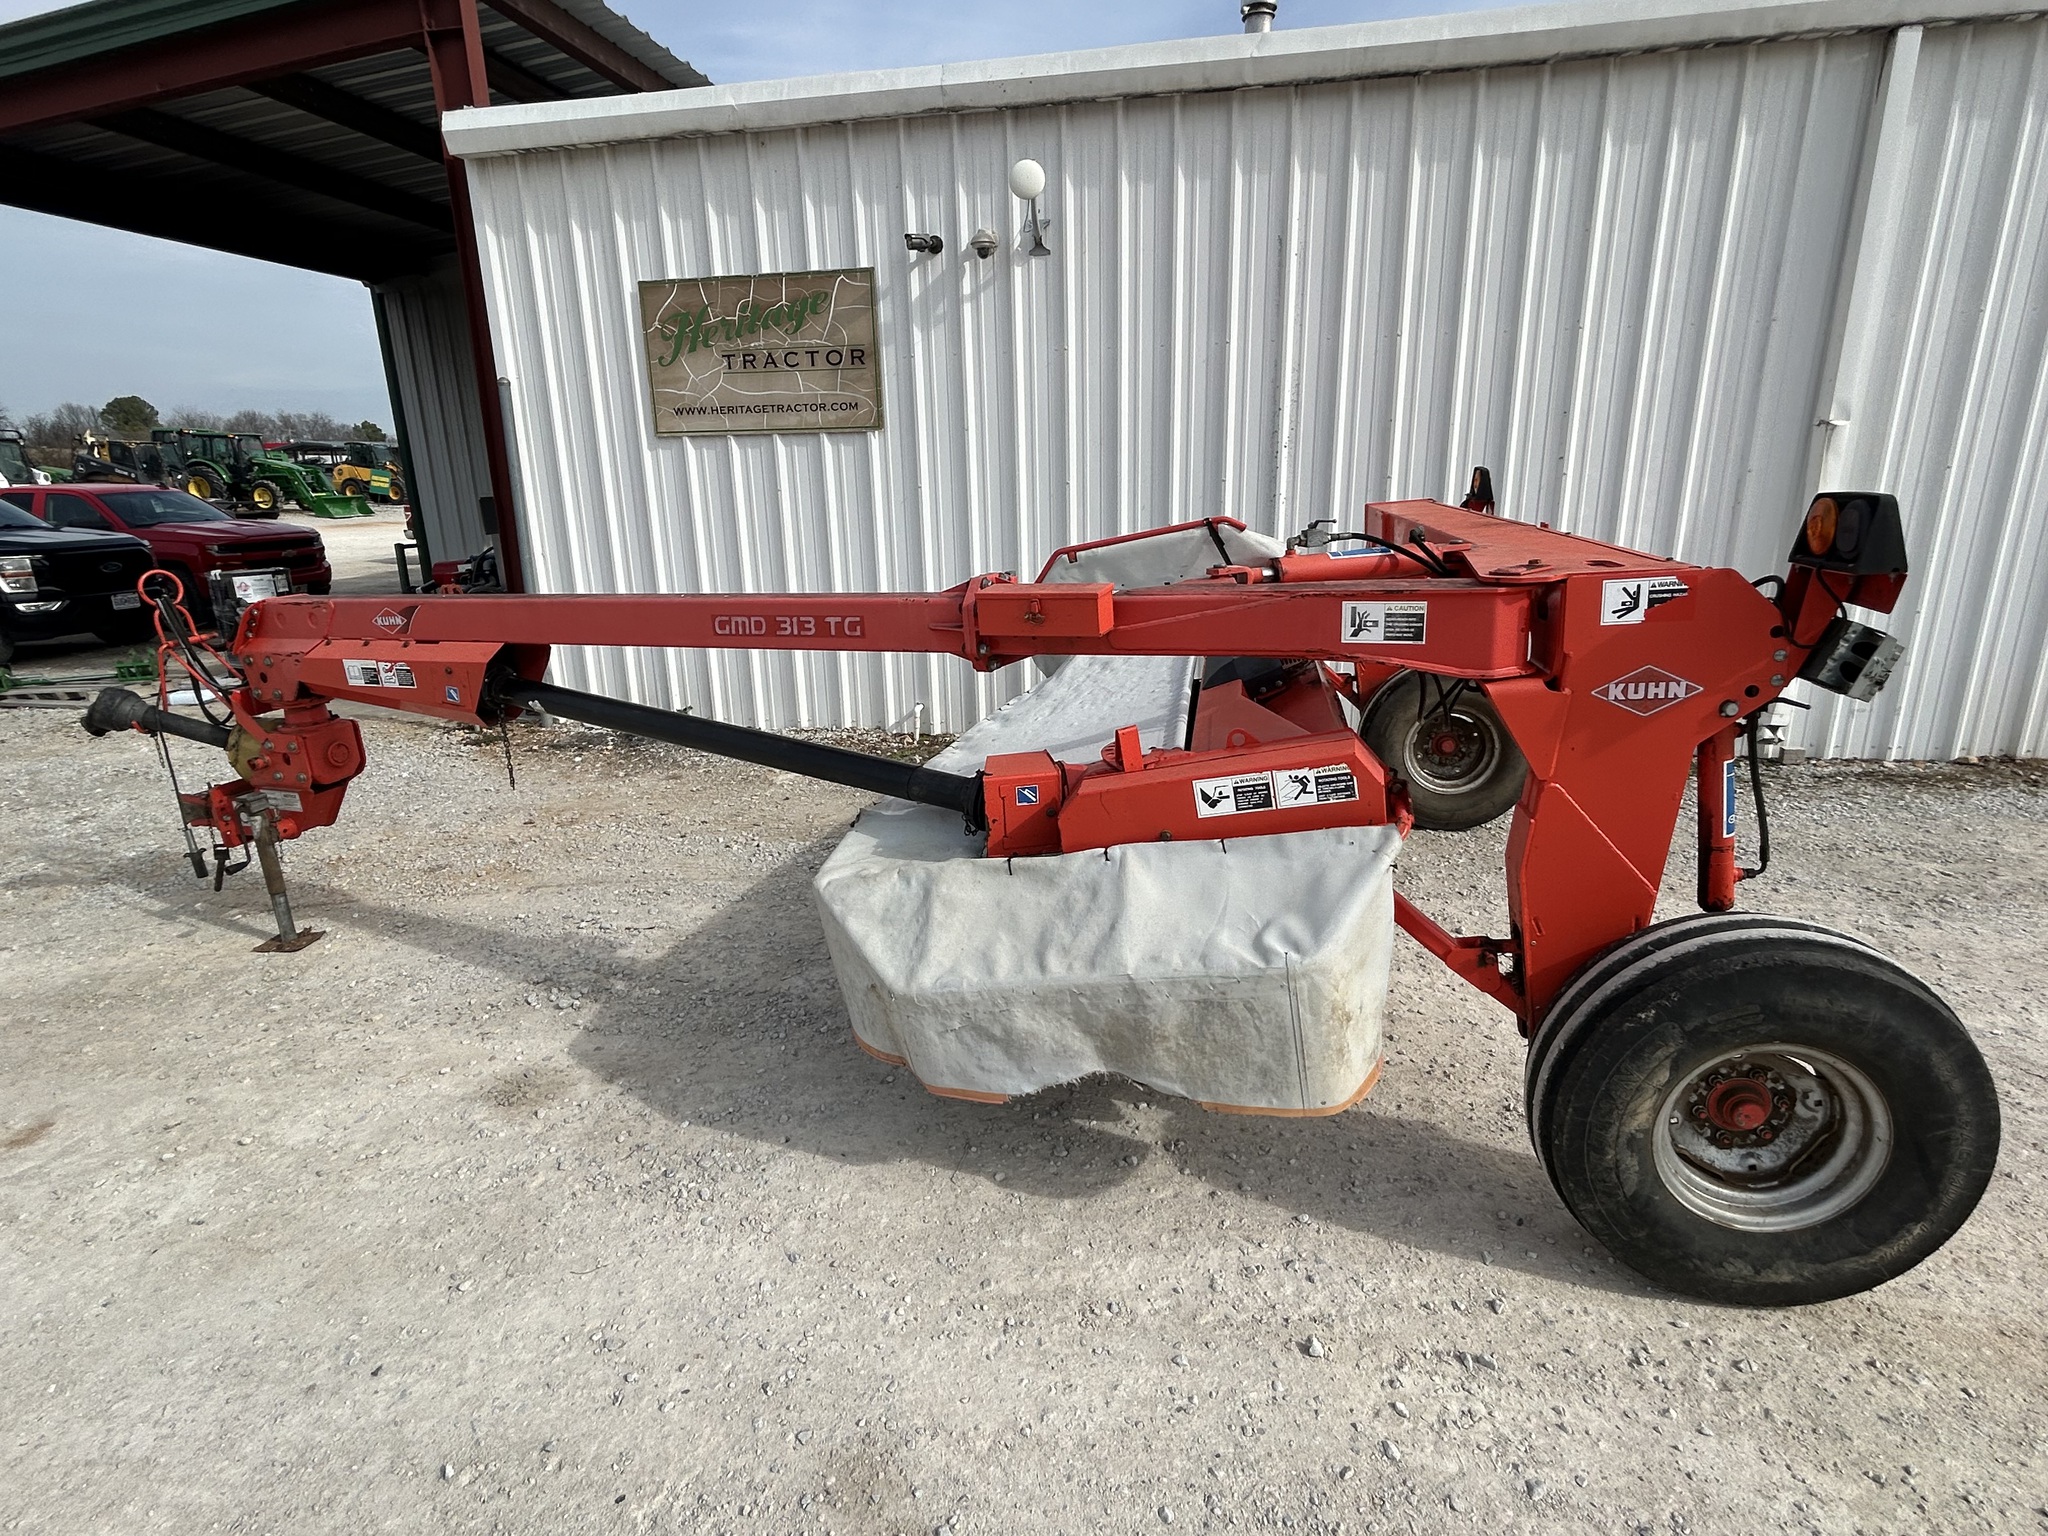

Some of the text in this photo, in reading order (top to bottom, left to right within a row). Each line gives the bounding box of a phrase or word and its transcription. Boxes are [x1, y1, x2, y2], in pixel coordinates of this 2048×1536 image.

[658, 291, 830, 367] Heritage
[722, 349, 866, 370] TRACTOR
[673, 402, 859, 416] WWW.HERITAGETRACTOR.COM
[1658, 580, 1687, 588] WARNI
[376, 616, 403, 626] KUHN
[714, 616, 861, 636] GMD 313 TG
[1608, 681, 1687, 700] KUHN
[1239, 775, 1268, 784] WARNING
